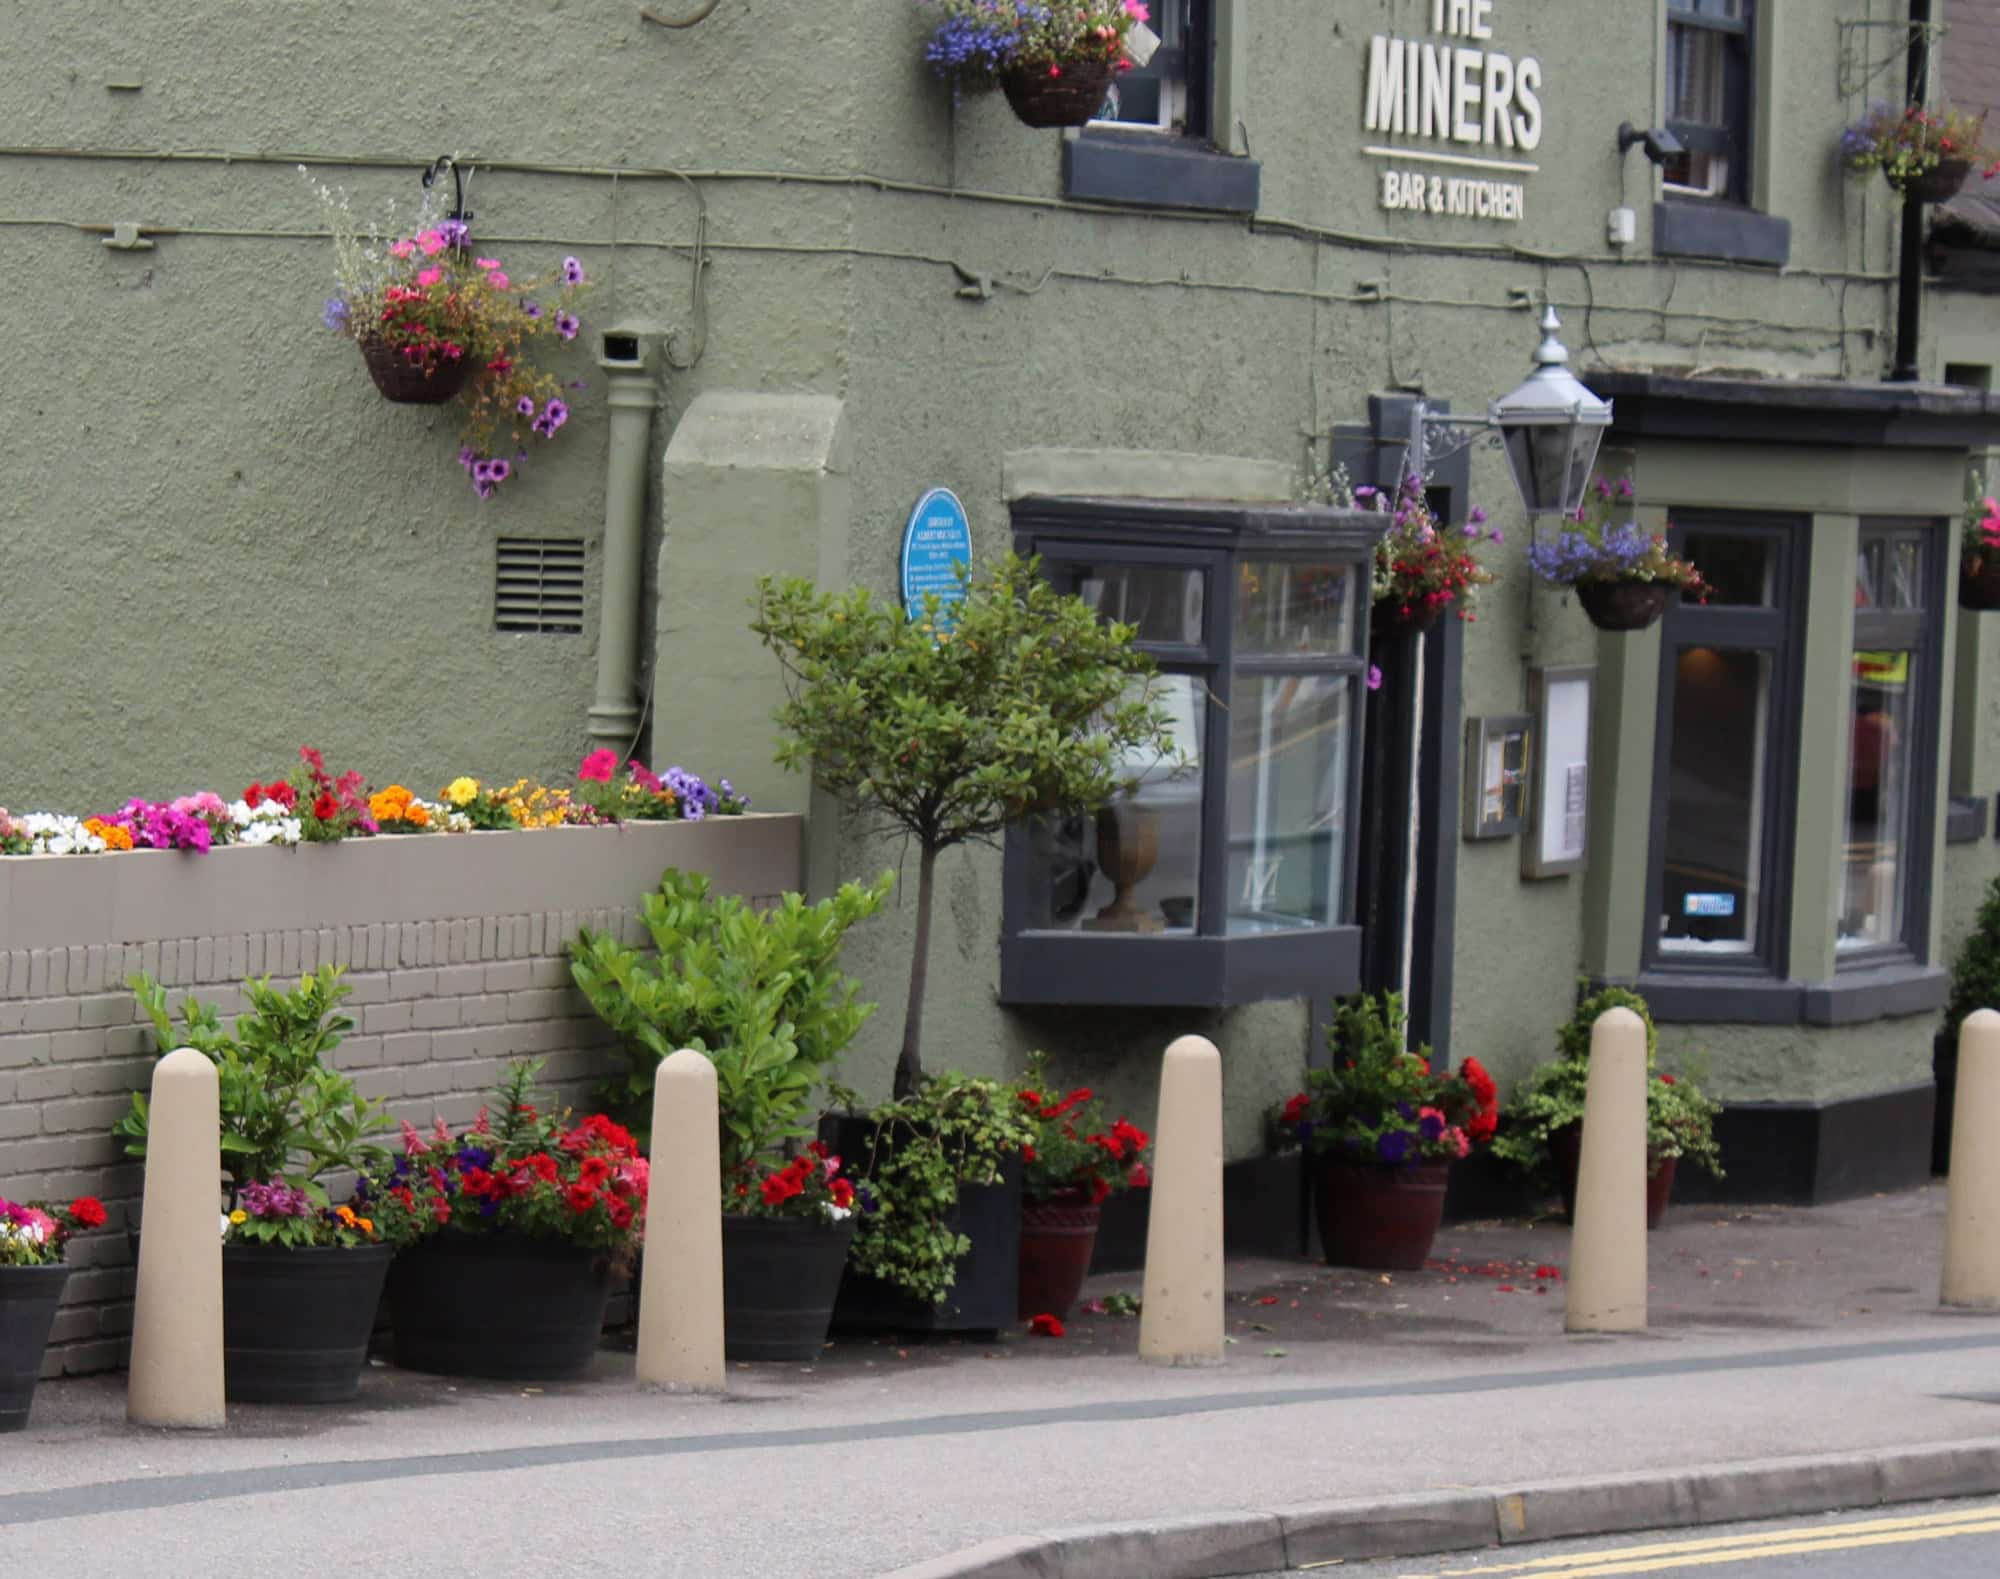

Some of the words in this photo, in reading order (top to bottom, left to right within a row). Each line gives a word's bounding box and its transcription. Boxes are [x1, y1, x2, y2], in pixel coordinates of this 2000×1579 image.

[1366, 36, 1542, 150] MINERS
[1383, 171, 1425, 210] BAR
[1428, 175, 1444, 213] &
[1446, 178, 1524, 219] KITCHEN
